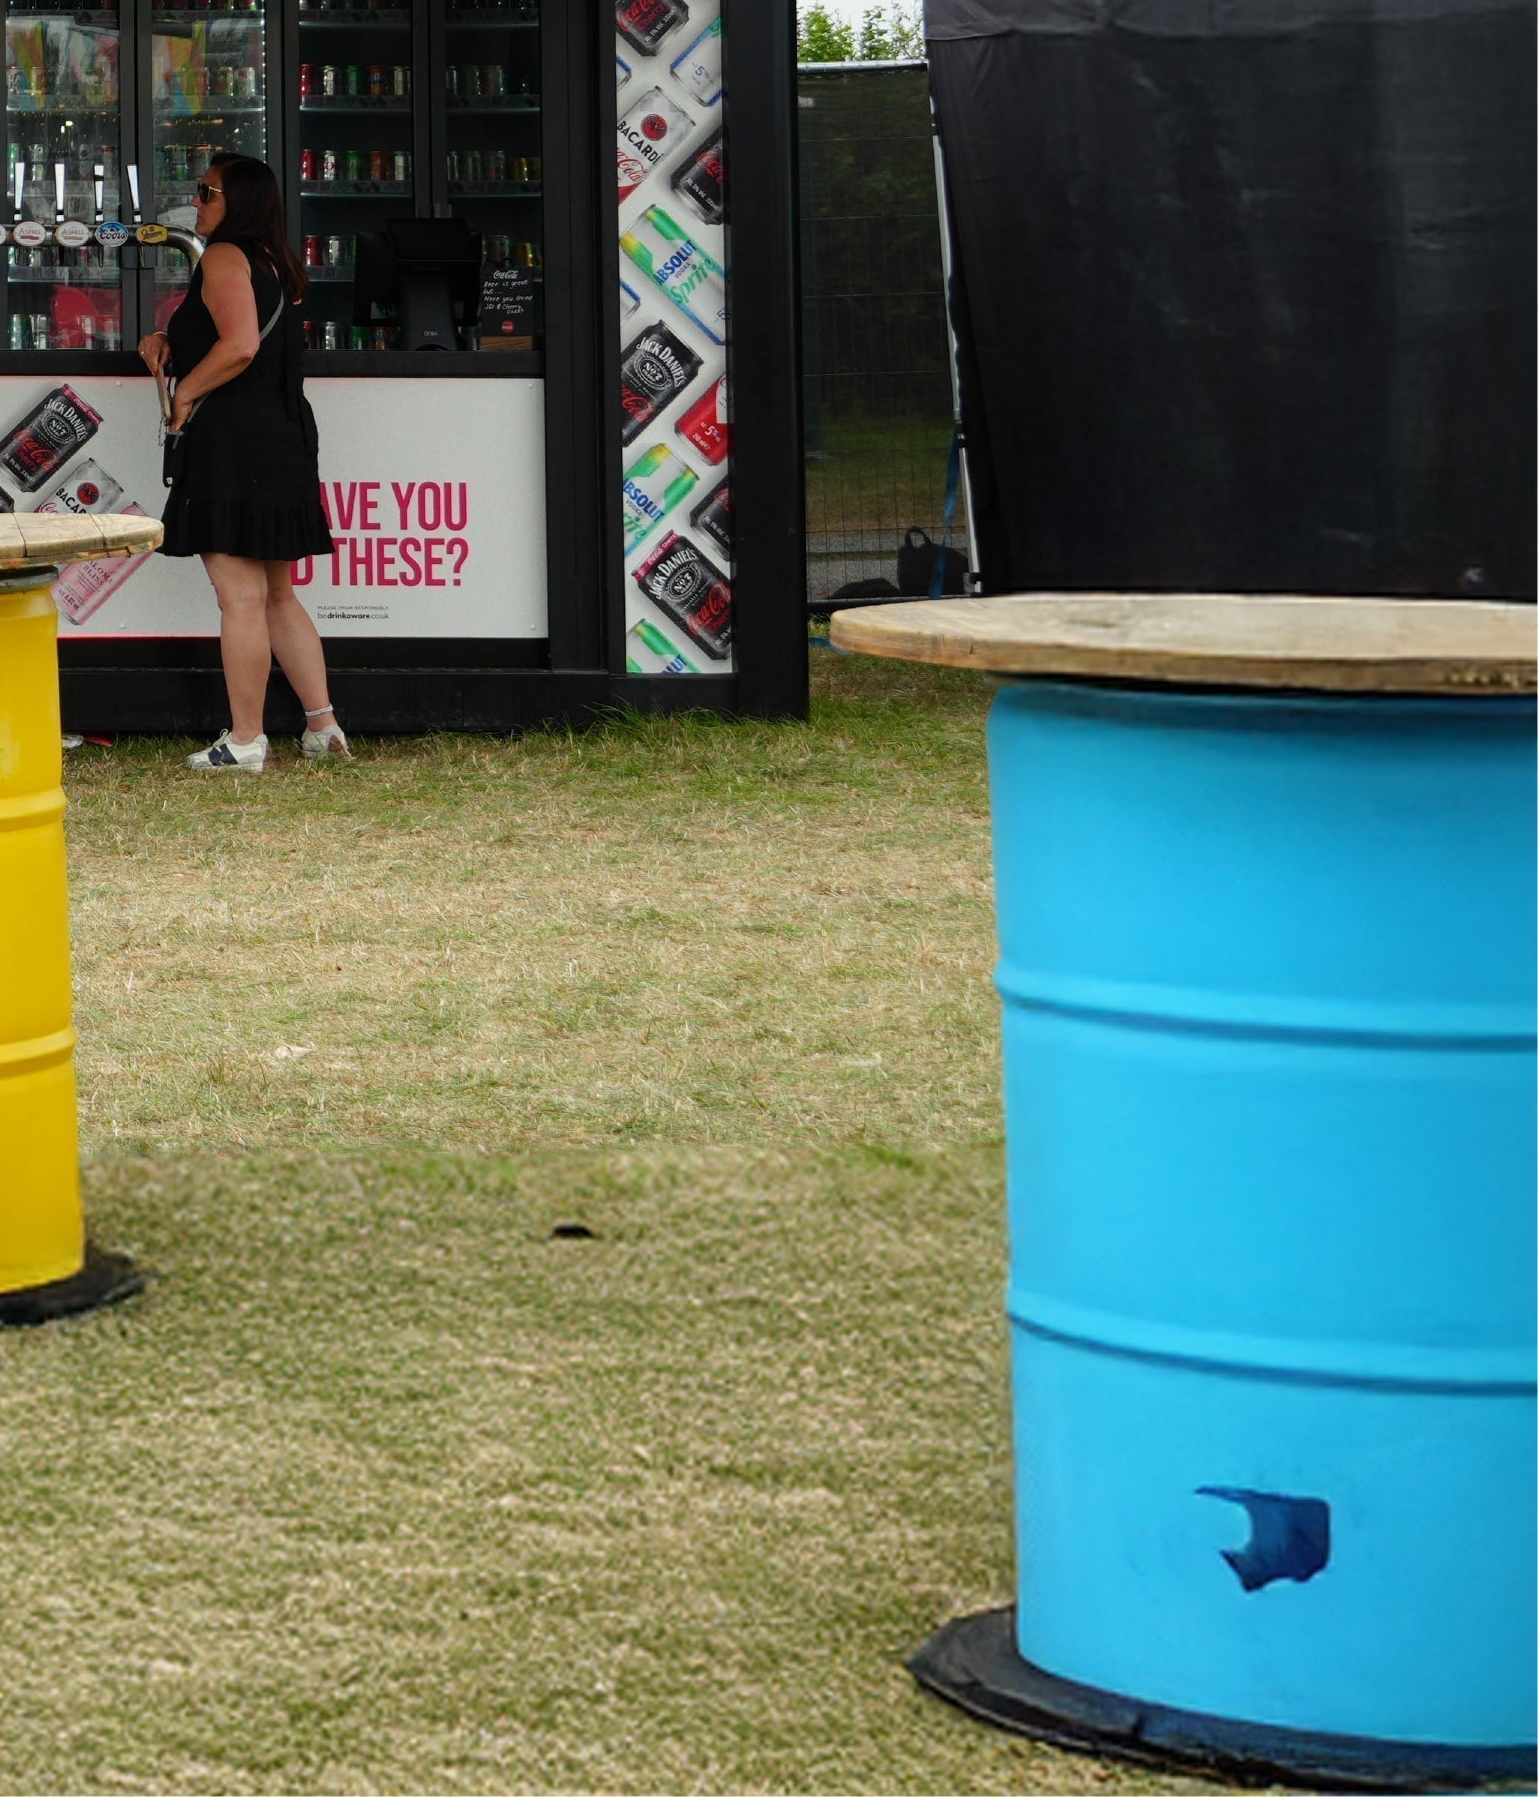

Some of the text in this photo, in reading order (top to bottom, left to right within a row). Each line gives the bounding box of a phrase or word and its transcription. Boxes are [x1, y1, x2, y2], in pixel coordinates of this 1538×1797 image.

[99, 229, 126, 240] Coors
[652, 239, 699, 287] ABSOLUT
[670, 258, 717, 305] Sprite
[636, 335, 688, 387] JACK DANIEL'S
[44, 397, 88, 443] JACK DANIEL'S
[390, 481, 468, 531] YOU
[330, 537, 469, 587] THESE?
[648, 548, 699, 600] JACK DANIEL'S
